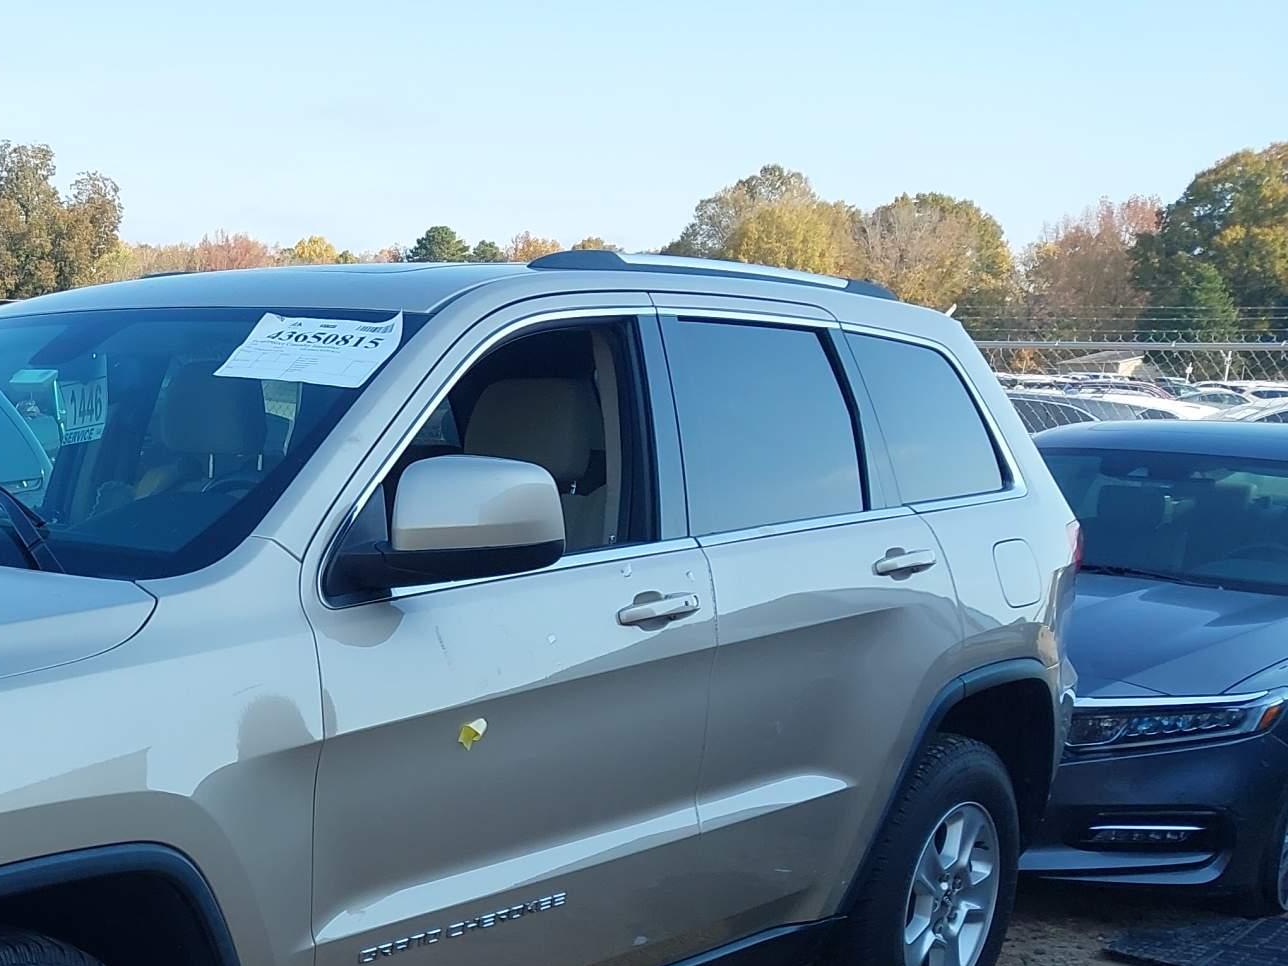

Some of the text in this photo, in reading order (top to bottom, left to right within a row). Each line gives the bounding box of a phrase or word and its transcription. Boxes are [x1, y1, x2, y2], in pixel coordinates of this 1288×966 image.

[267, 330, 385, 350] 43650815
[359, 892, 568, 964] GRAND CHEROKEE
